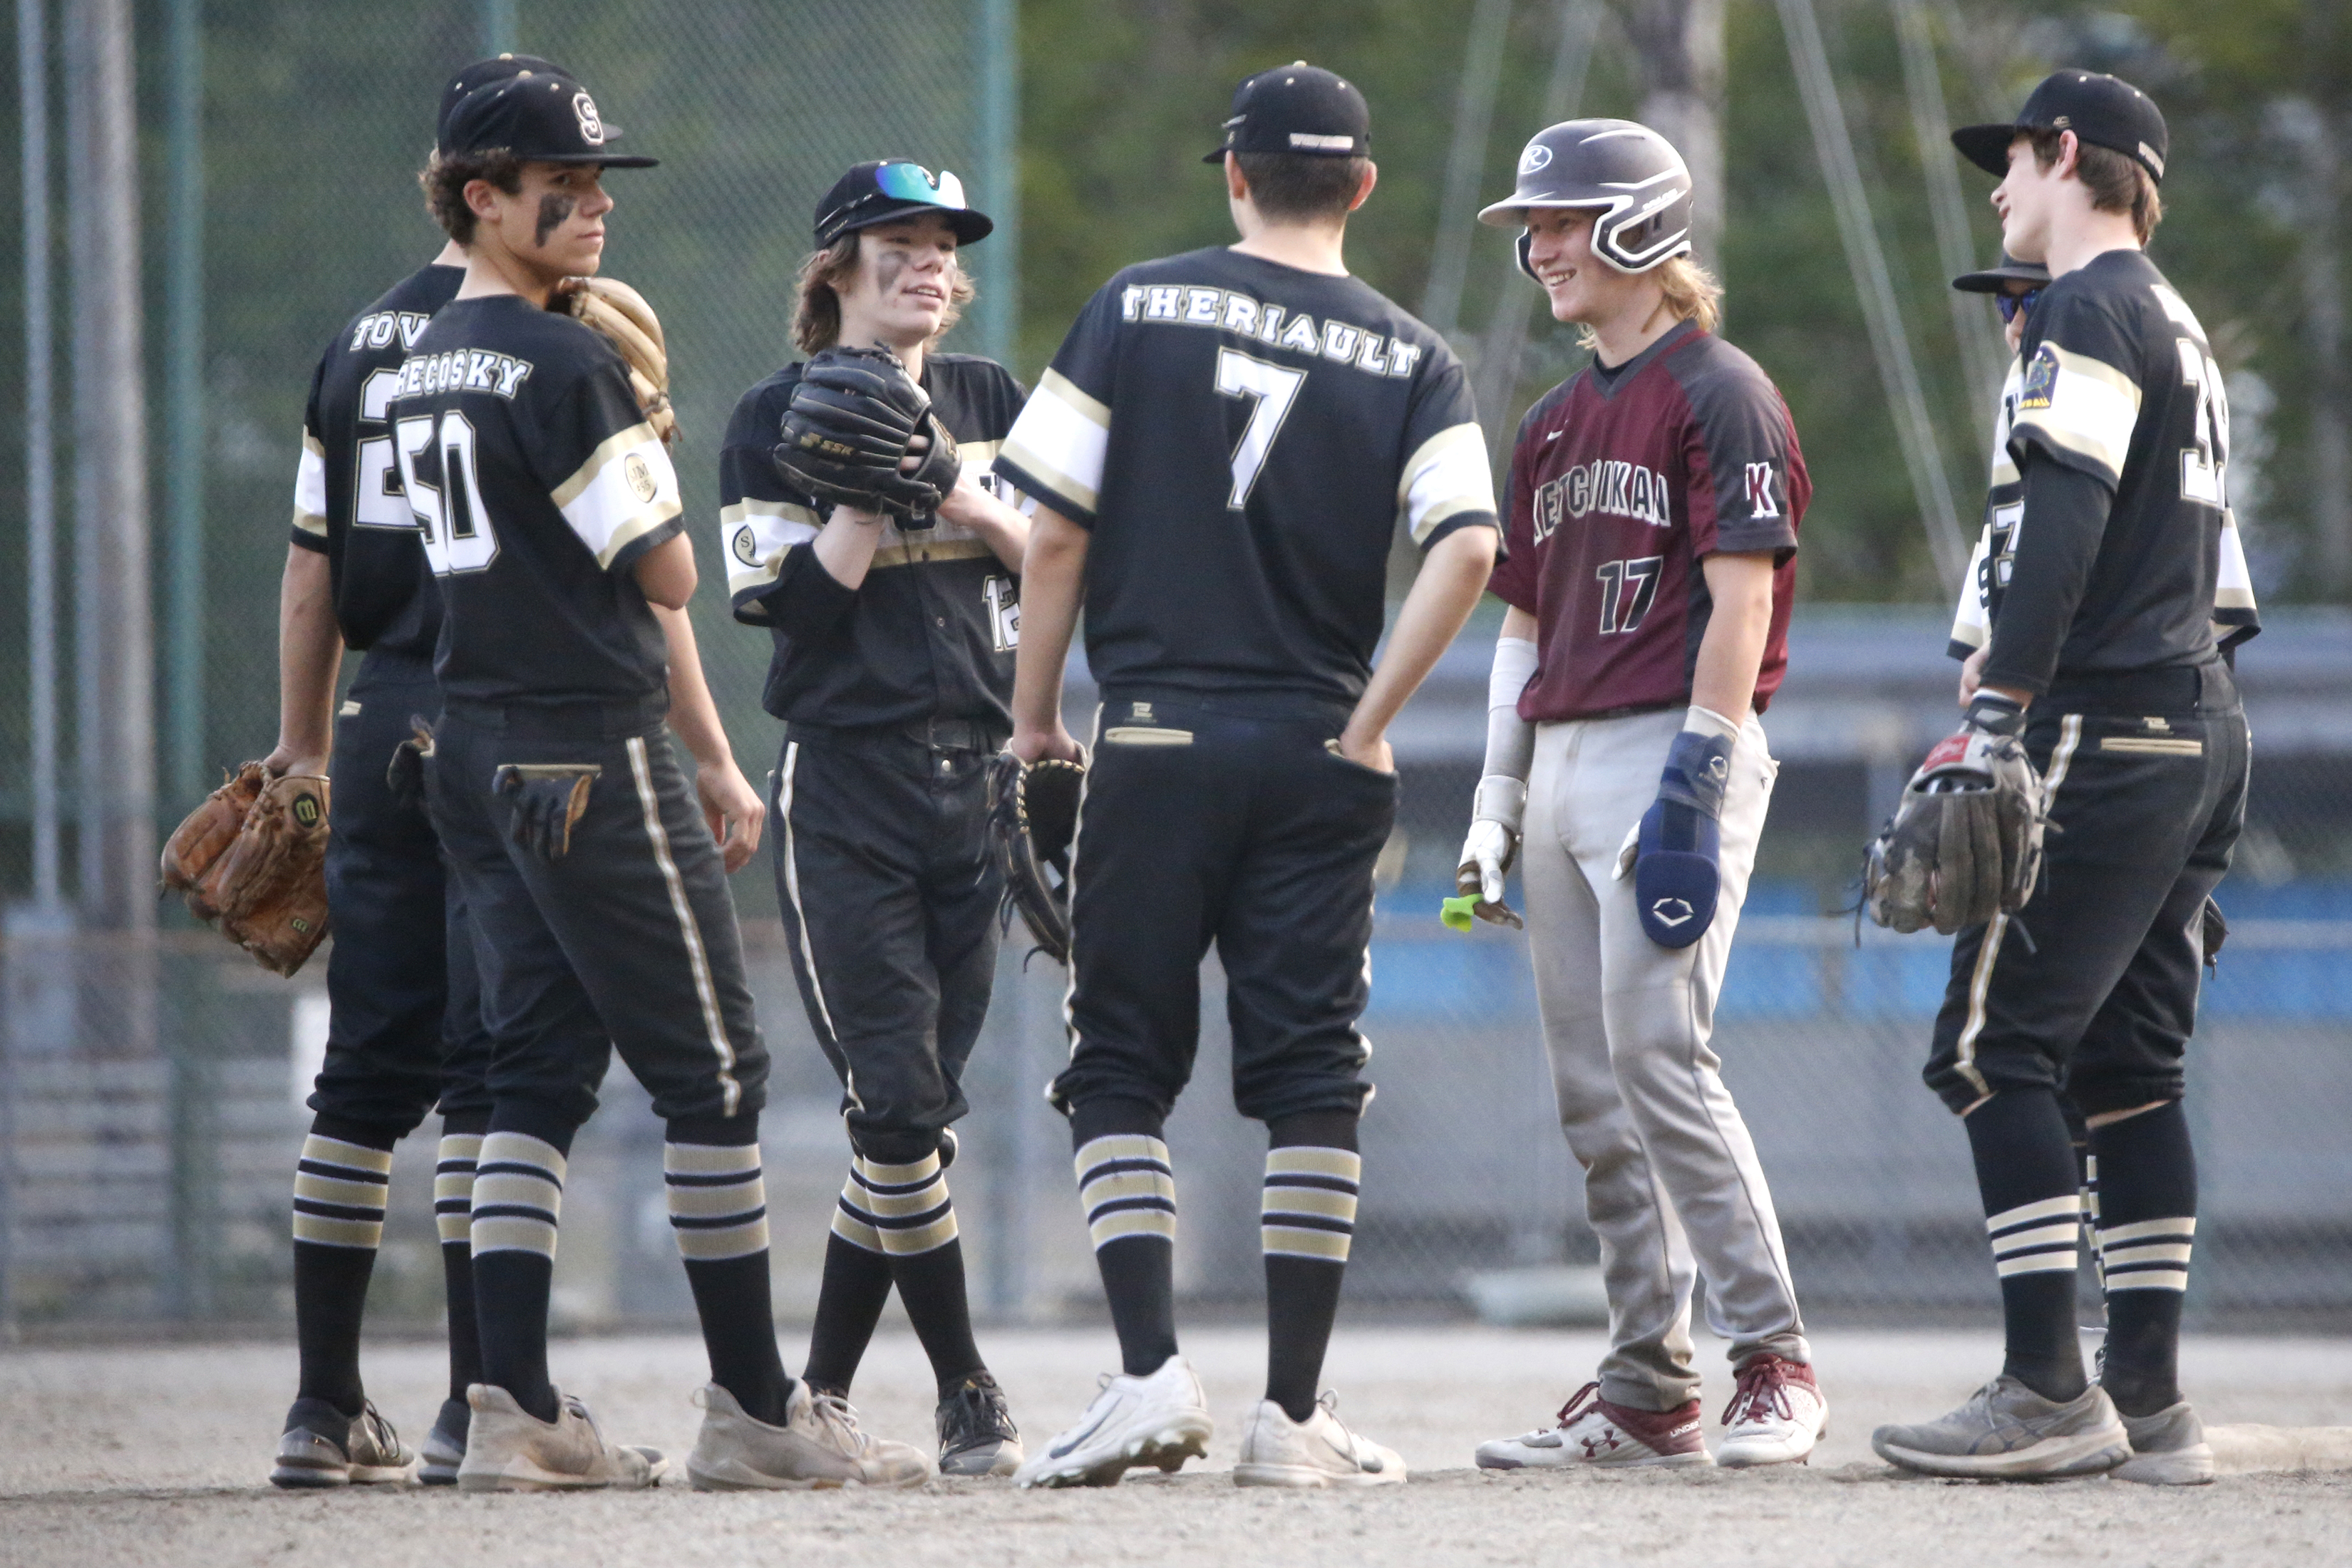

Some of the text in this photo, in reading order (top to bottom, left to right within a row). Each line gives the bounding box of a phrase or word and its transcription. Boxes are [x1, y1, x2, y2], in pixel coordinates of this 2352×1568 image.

[349, 311, 433, 351] TOV
[1122, 284, 1420, 378] THERIAULT
[1213, 345, 1308, 511] 7
[396, 409, 500, 578] 50
[1745, 462, 1779, 518] K
[1596, 555, 1664, 634] 17
[1669, 1420, 1700, 1438] UNDER
